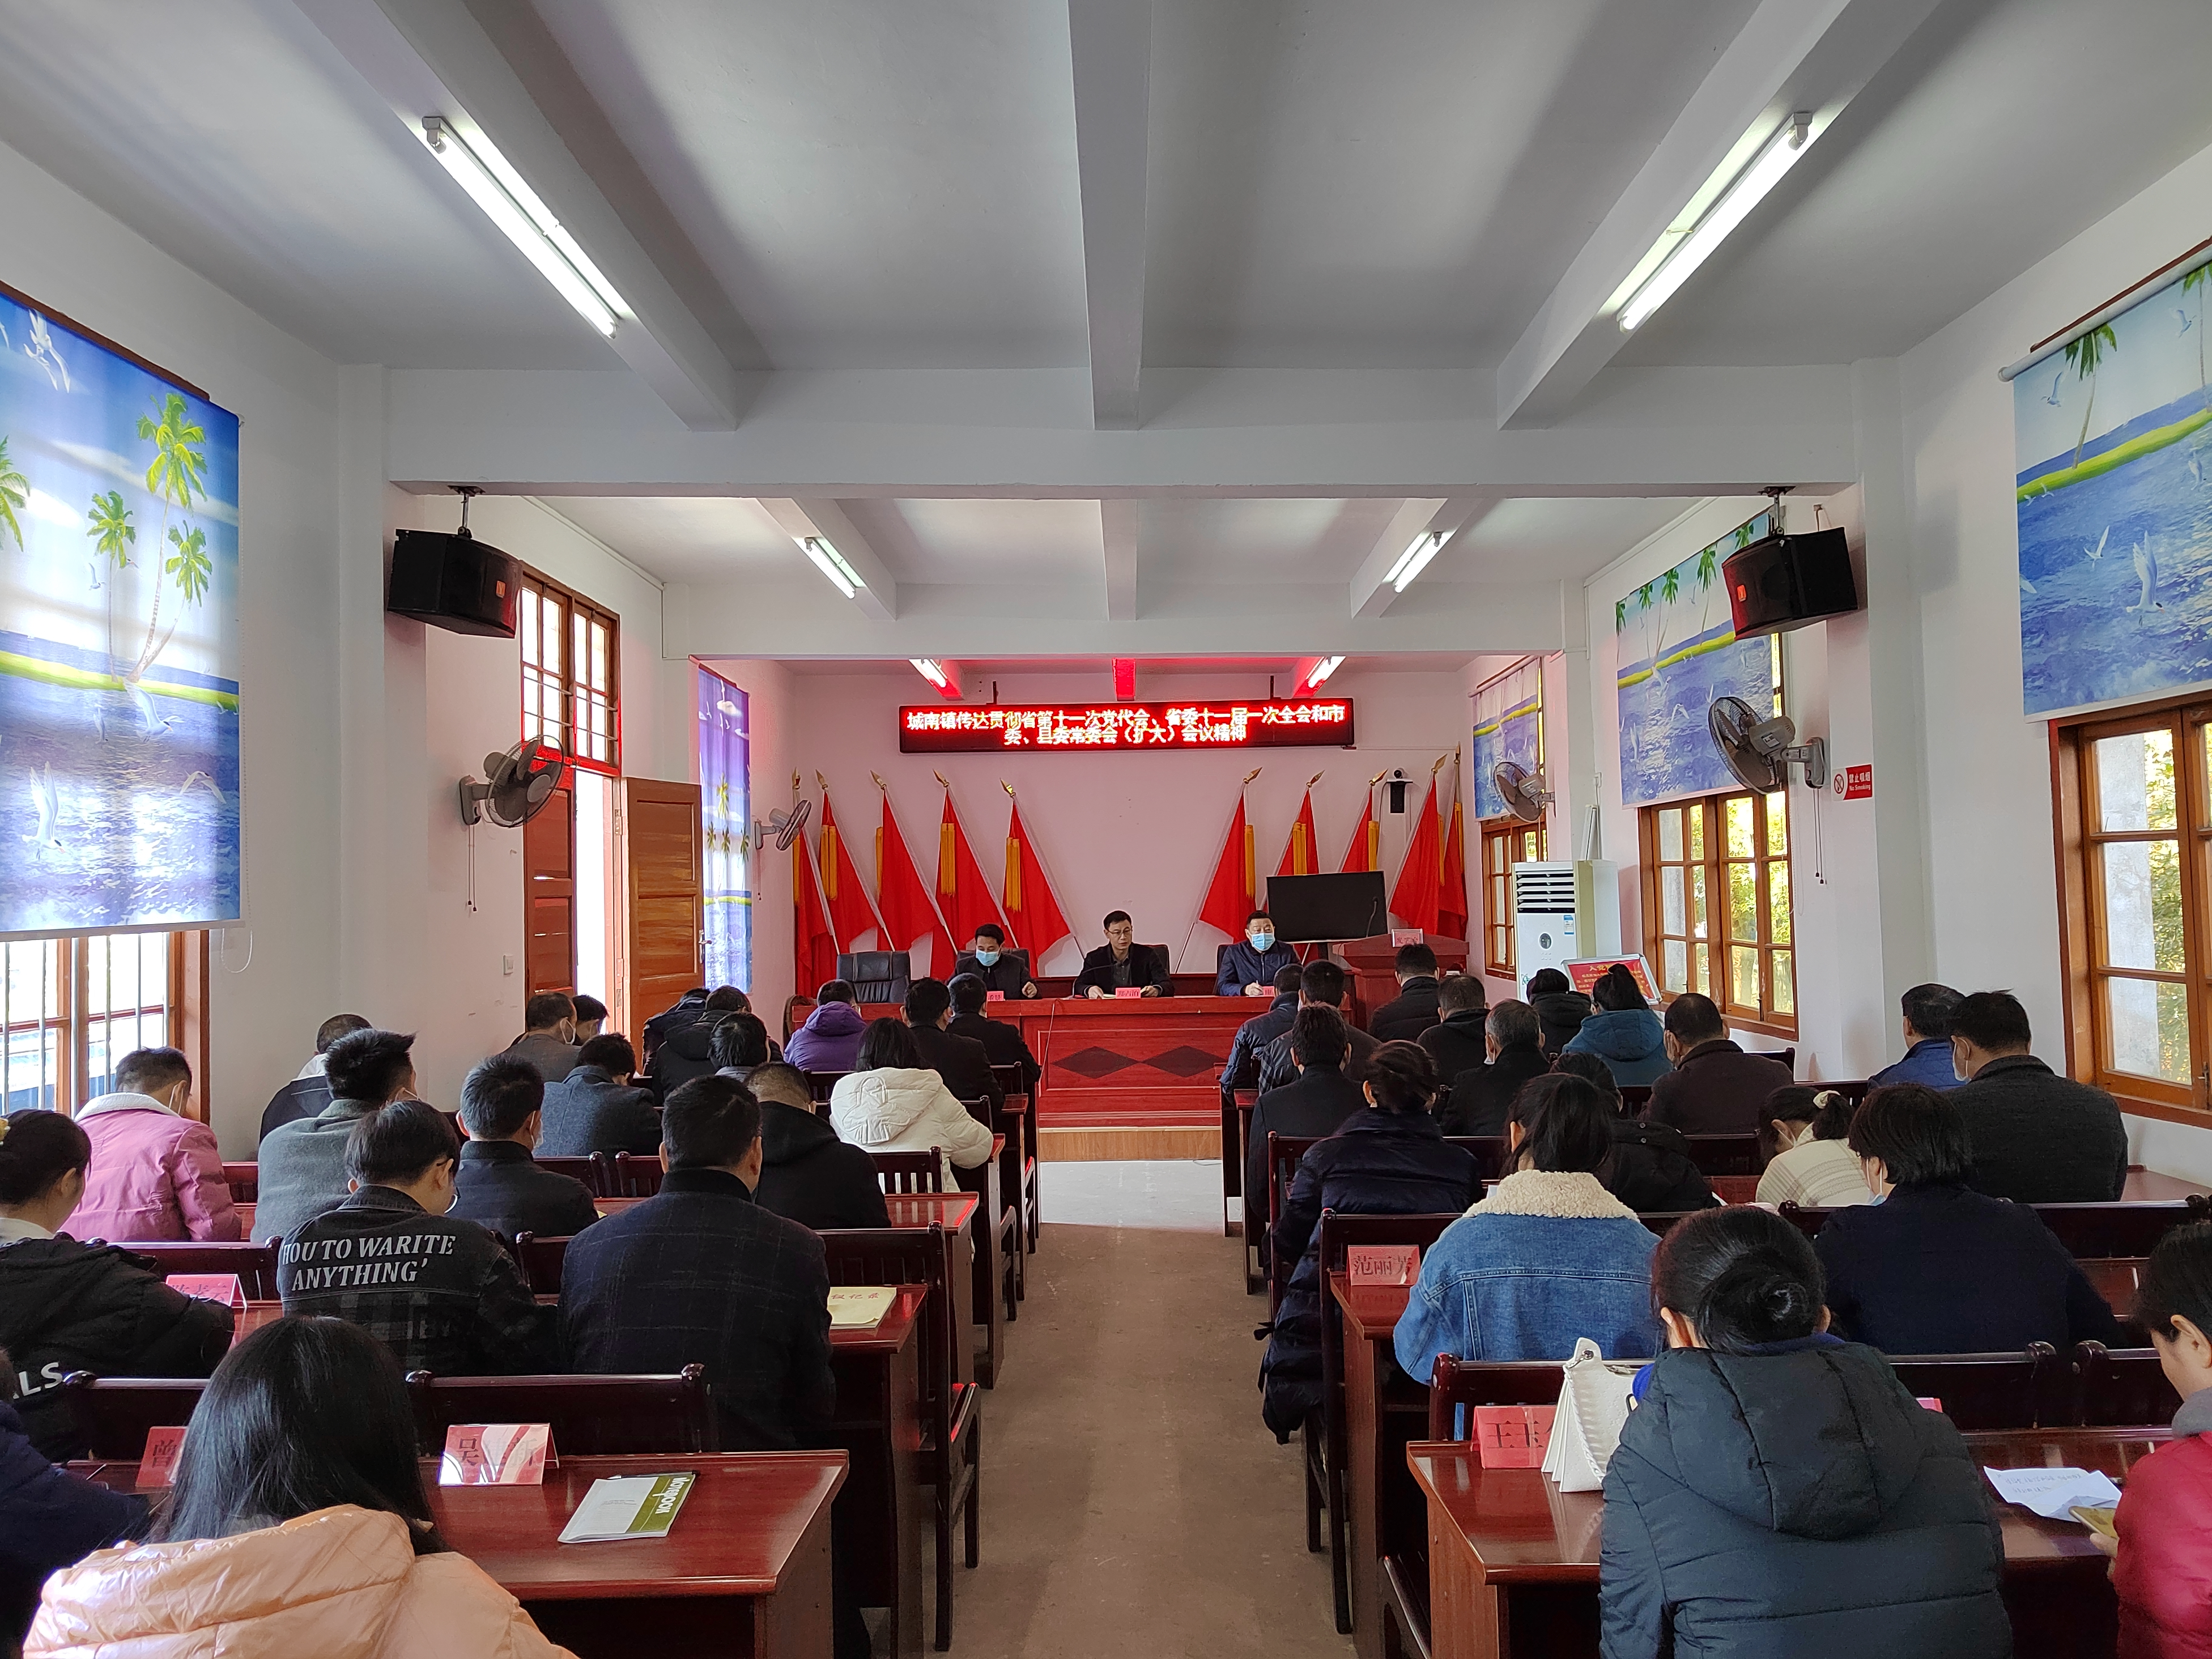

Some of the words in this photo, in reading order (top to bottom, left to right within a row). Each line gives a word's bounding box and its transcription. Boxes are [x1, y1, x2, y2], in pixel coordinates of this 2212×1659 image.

[322, 1238, 352, 1260] TO
[358, 1235, 456, 1258] WARITE
[13, 1362, 63, 1399] LS
